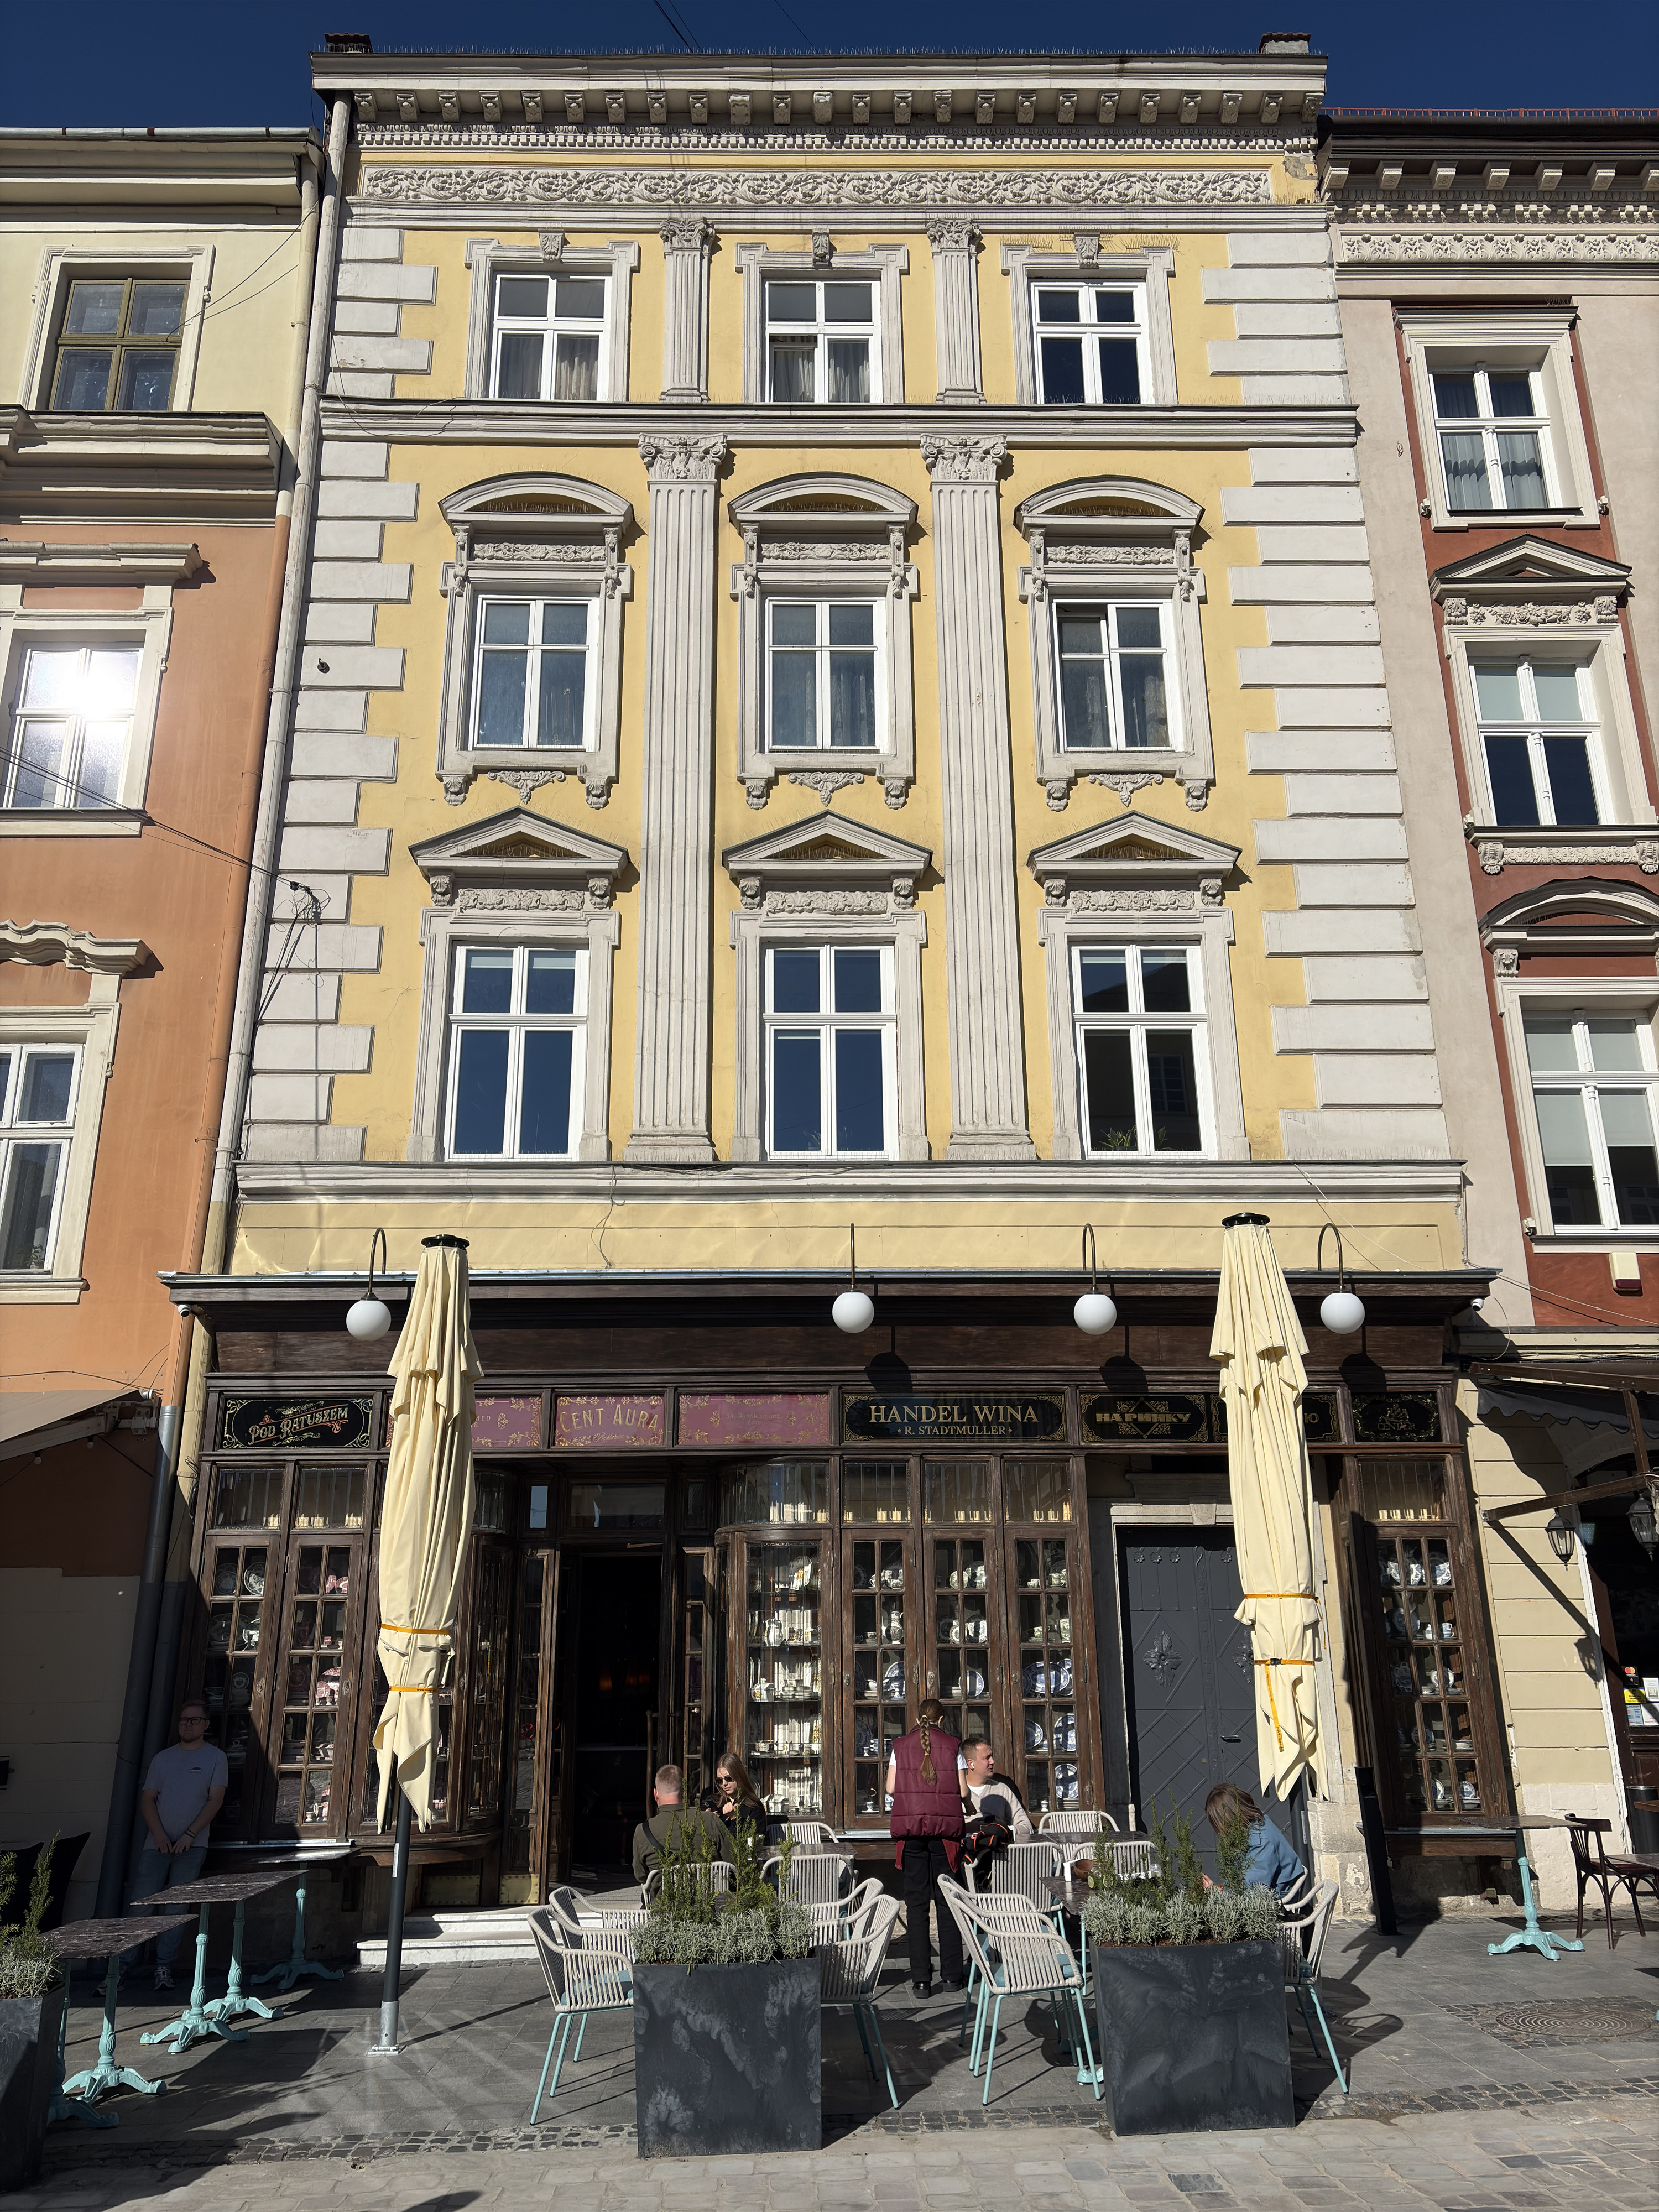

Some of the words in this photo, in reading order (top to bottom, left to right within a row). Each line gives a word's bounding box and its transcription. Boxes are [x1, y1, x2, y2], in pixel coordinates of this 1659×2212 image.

[559, 1408, 604, 1433] CENT
[613, 1404, 659, 1432] AURA
[869, 1405, 967, 1422] HANDEL
[973, 1405, 1039, 1422] WINA
[1095, 1413, 1123, 1422] НА
[1124, 1413, 1191, 1422] РИНКУ
[248, 1425, 276, 1446] POD
[279, 1407, 348, 1439] RATUSZEM
[904, 1427, 915, 1435] R.
[919, 1426, 1006, 1436] STADTMULLER
